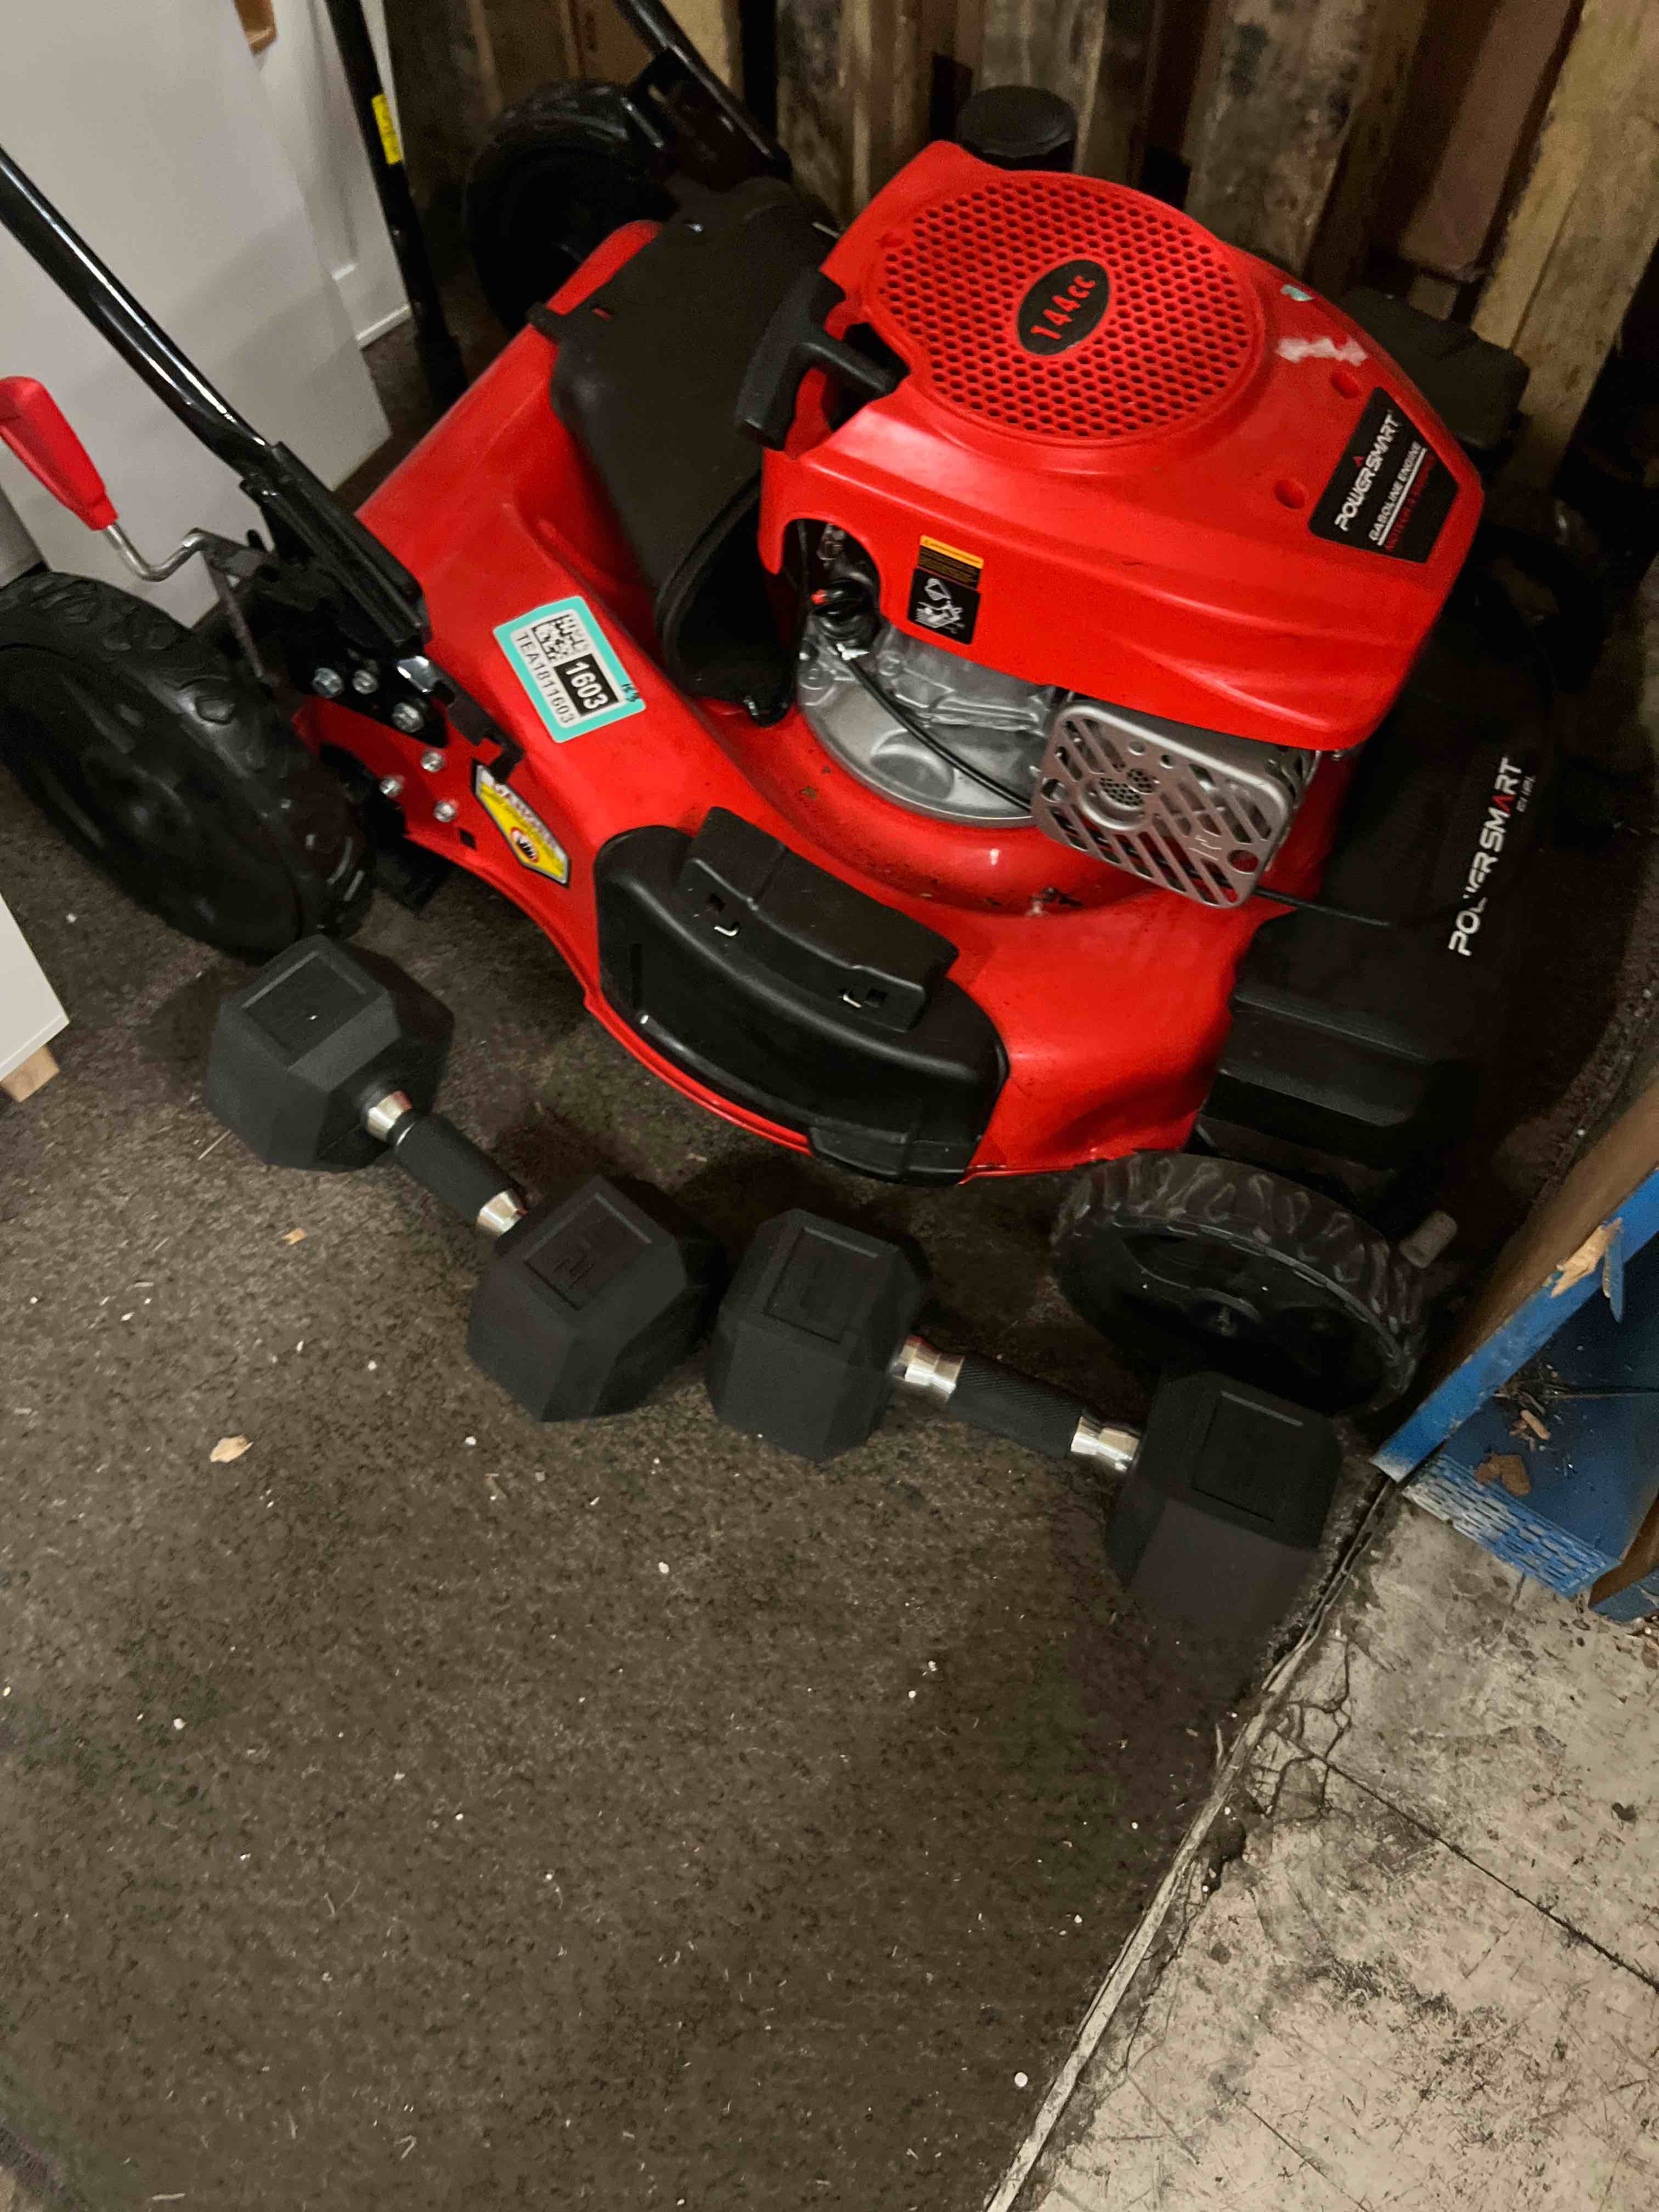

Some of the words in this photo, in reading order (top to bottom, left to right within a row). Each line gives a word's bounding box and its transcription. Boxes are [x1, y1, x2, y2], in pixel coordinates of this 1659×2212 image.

[1030, 275, 1096, 340] 144cc
[1334, 411, 1399, 532] POWERSMART
[565, 662, 608, 710] 1603
